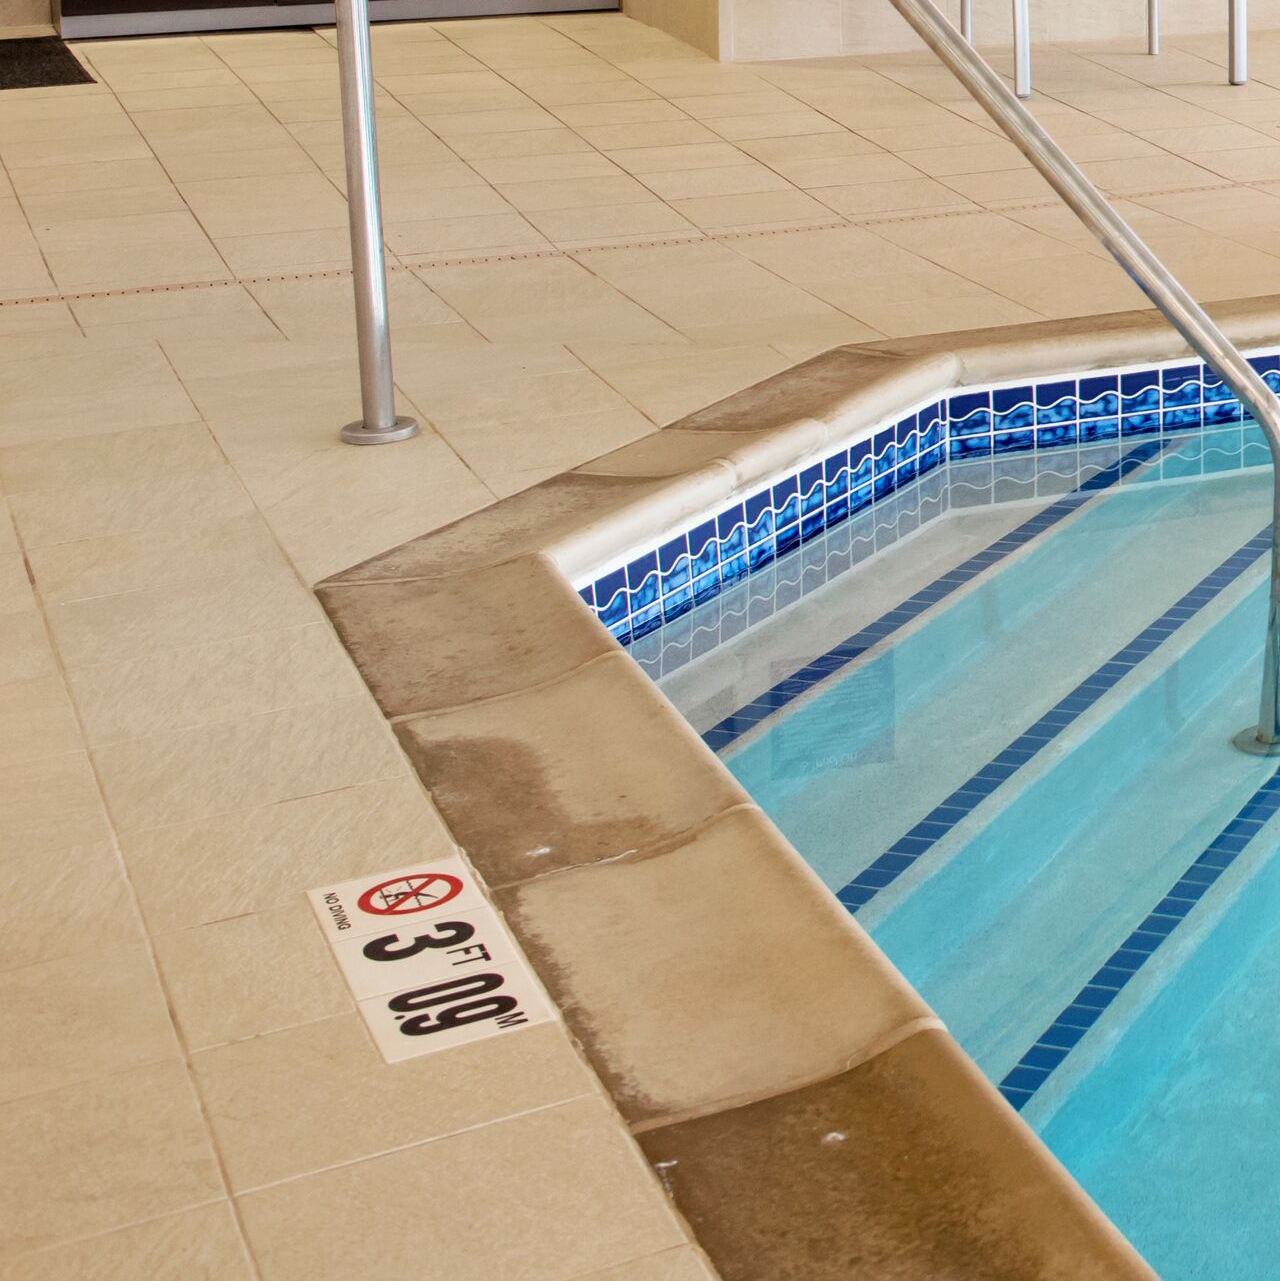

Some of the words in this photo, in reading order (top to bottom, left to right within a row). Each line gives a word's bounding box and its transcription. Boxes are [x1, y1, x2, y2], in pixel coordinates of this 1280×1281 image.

[323, 892, 340, 904] NO
[328, 906, 352, 930] DIVING
[363, 921, 475, 962] 3
[446, 943, 492, 966] FT
